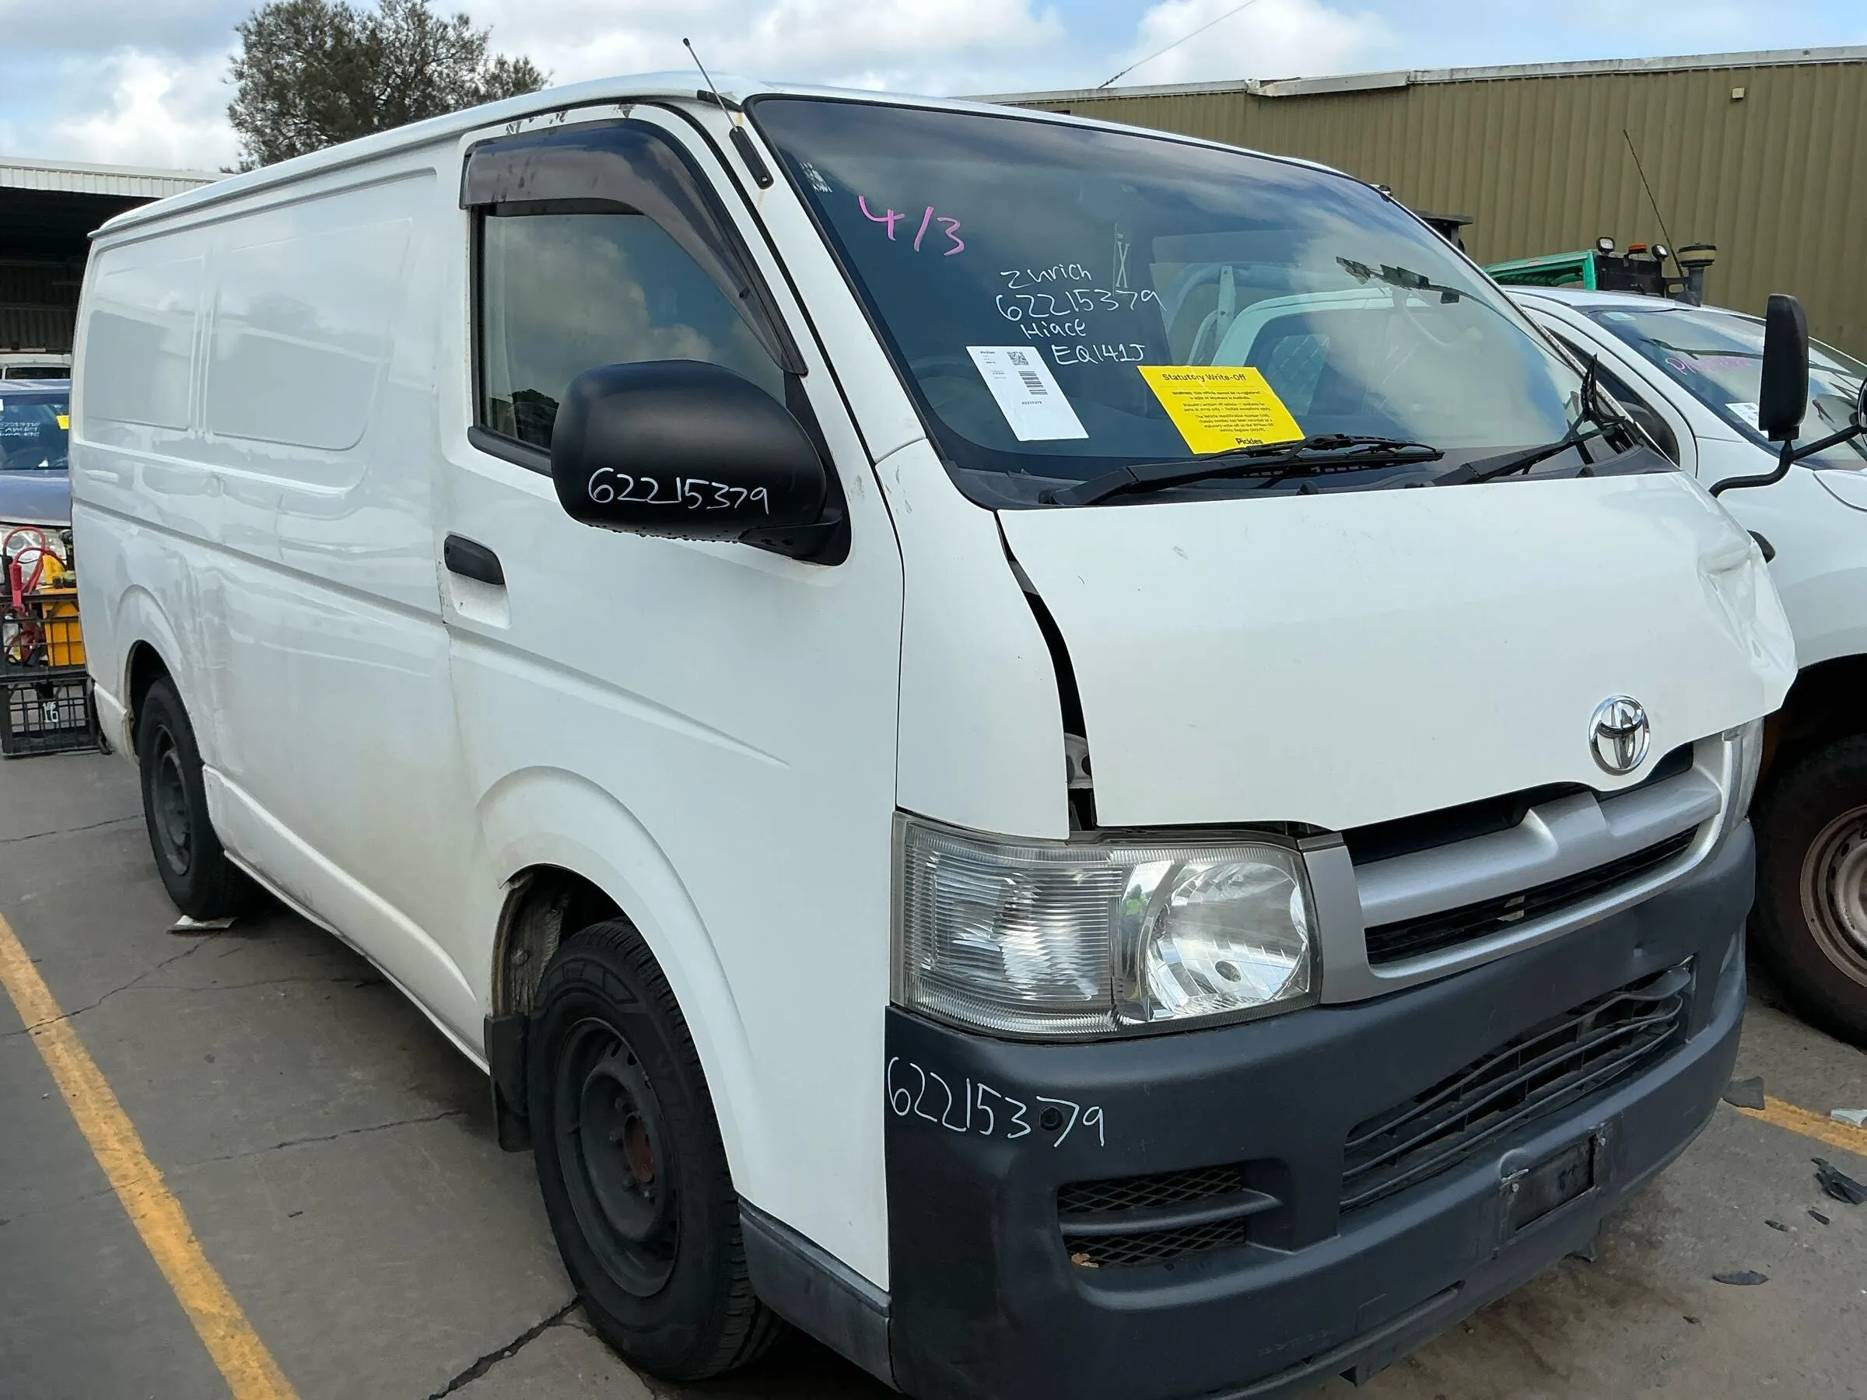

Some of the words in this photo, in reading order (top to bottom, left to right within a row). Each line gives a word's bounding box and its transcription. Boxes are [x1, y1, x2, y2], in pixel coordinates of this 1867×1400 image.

[858, 194, 965, 256] 4/3
[995, 289, 1168, 321] 62215379
[1051, 343, 1146, 365] EQ141J
[1162, 373, 1205, 382] Statutory
[1205, 373, 1247, 381] Write-Off
[587, 466, 770, 515] 62215379
[886, 1056, 1106, 1148] 62215379
